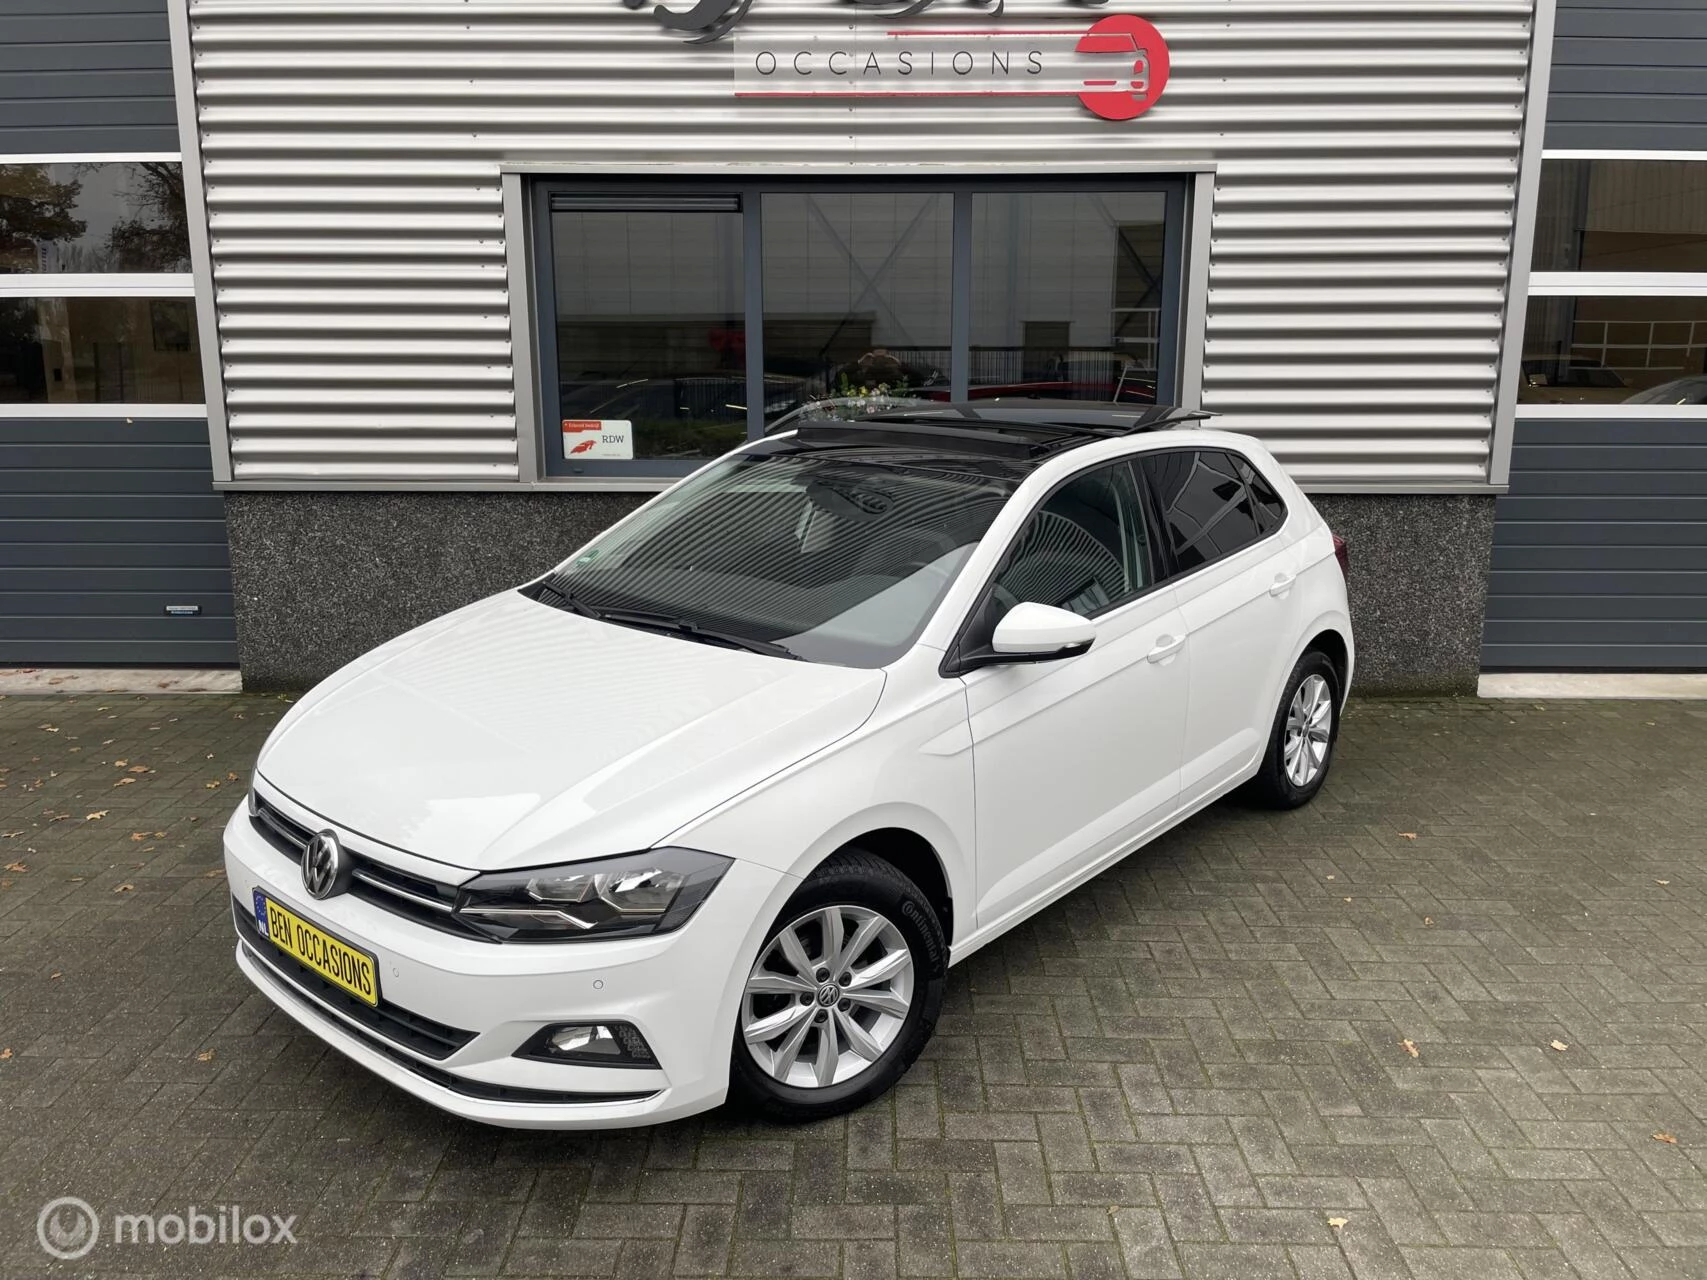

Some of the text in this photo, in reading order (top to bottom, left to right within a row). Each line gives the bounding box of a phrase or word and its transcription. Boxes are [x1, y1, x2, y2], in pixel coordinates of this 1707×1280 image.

[755, 50, 1044, 76] OCCASIONS
[602, 435, 625, 444] RDW
[258, 919, 270, 937] NL
[269, 907, 372, 996] BEN OCCASIONS
